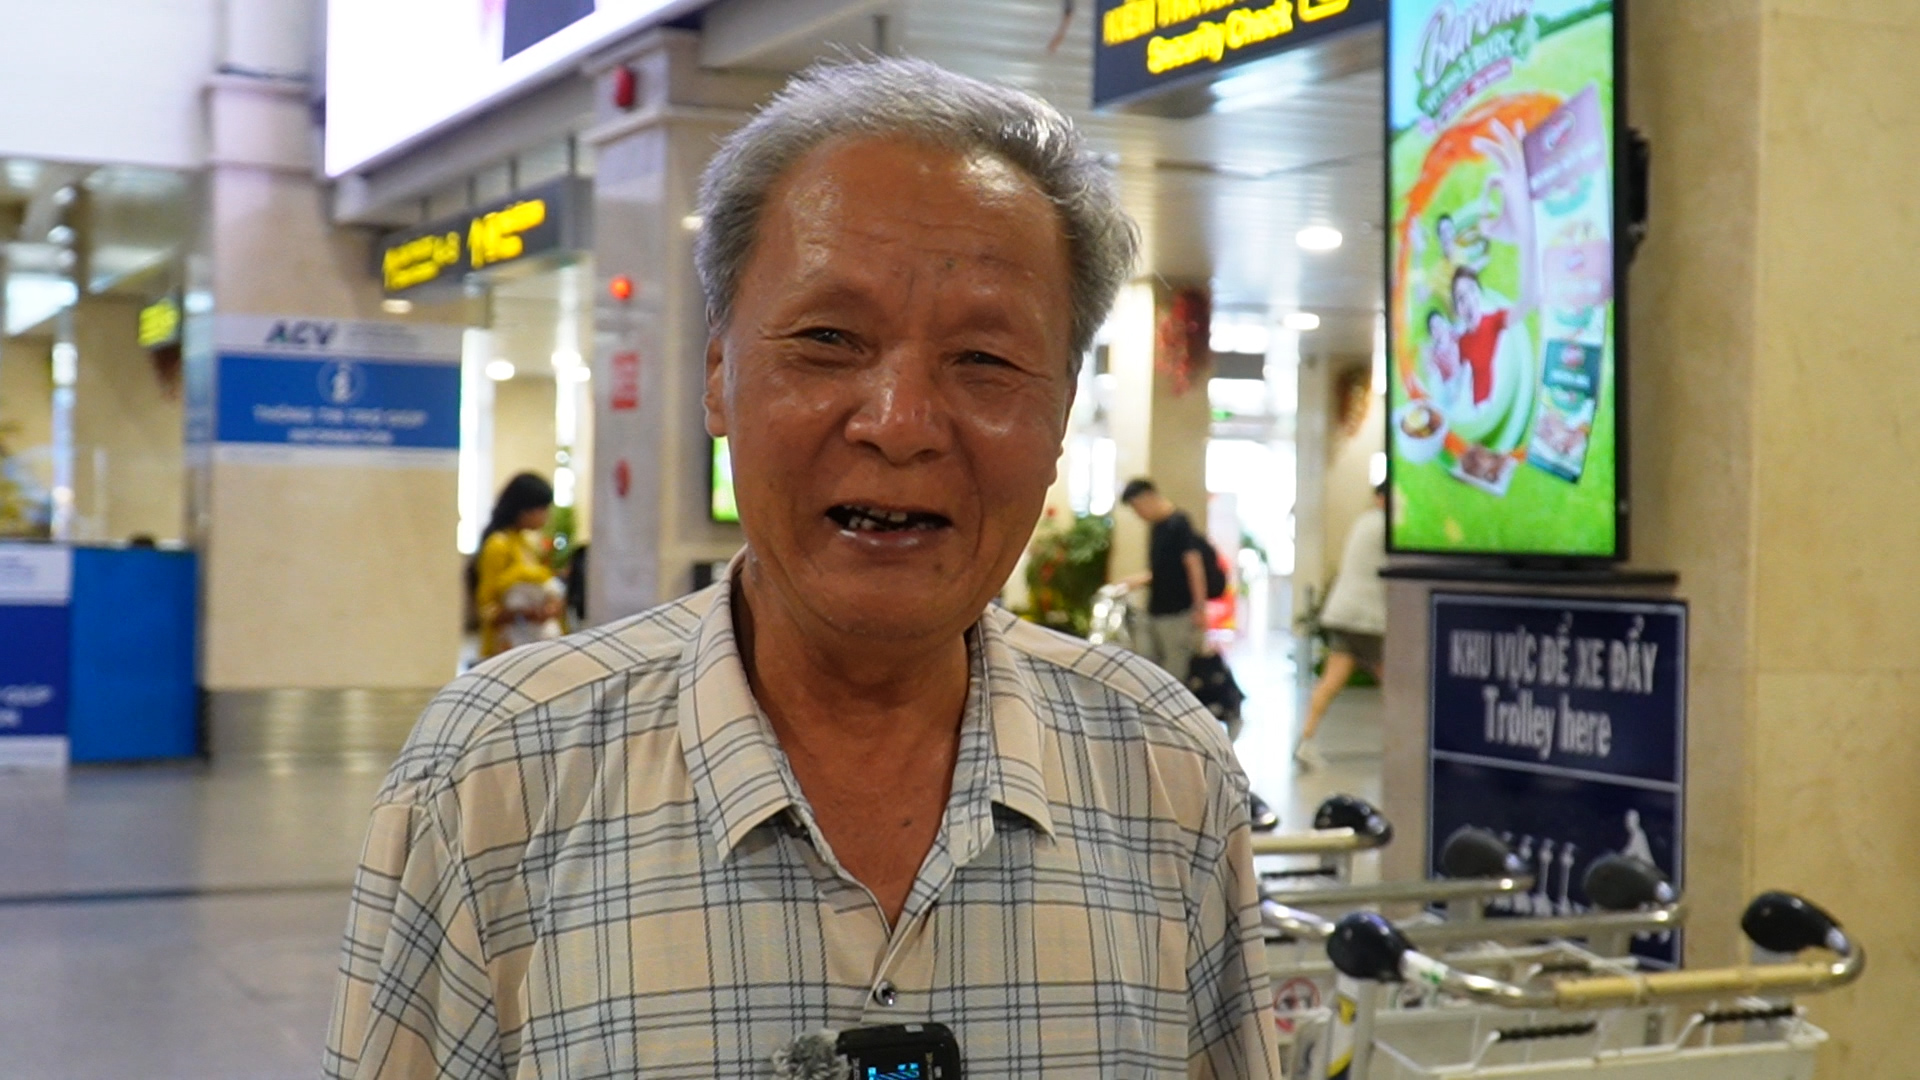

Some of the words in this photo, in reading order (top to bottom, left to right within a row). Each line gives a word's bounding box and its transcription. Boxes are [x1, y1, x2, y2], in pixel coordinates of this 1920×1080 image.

[1147, 21, 1225, 74] Security
[1225, 0, 1293, 49] Check
[265, 320, 339, 345] ACV
[1449, 628, 1493, 680] KHU
[1494, 623, 1538, 691] VỰC
[1538, 610, 1571, 689] ĐỂ
[1572, 637, 1606, 691] XE
[1607, 613, 1659, 696] ĐẨY
[1481, 684, 1556, 761] Trolley
[1558, 692, 1612, 759] here
